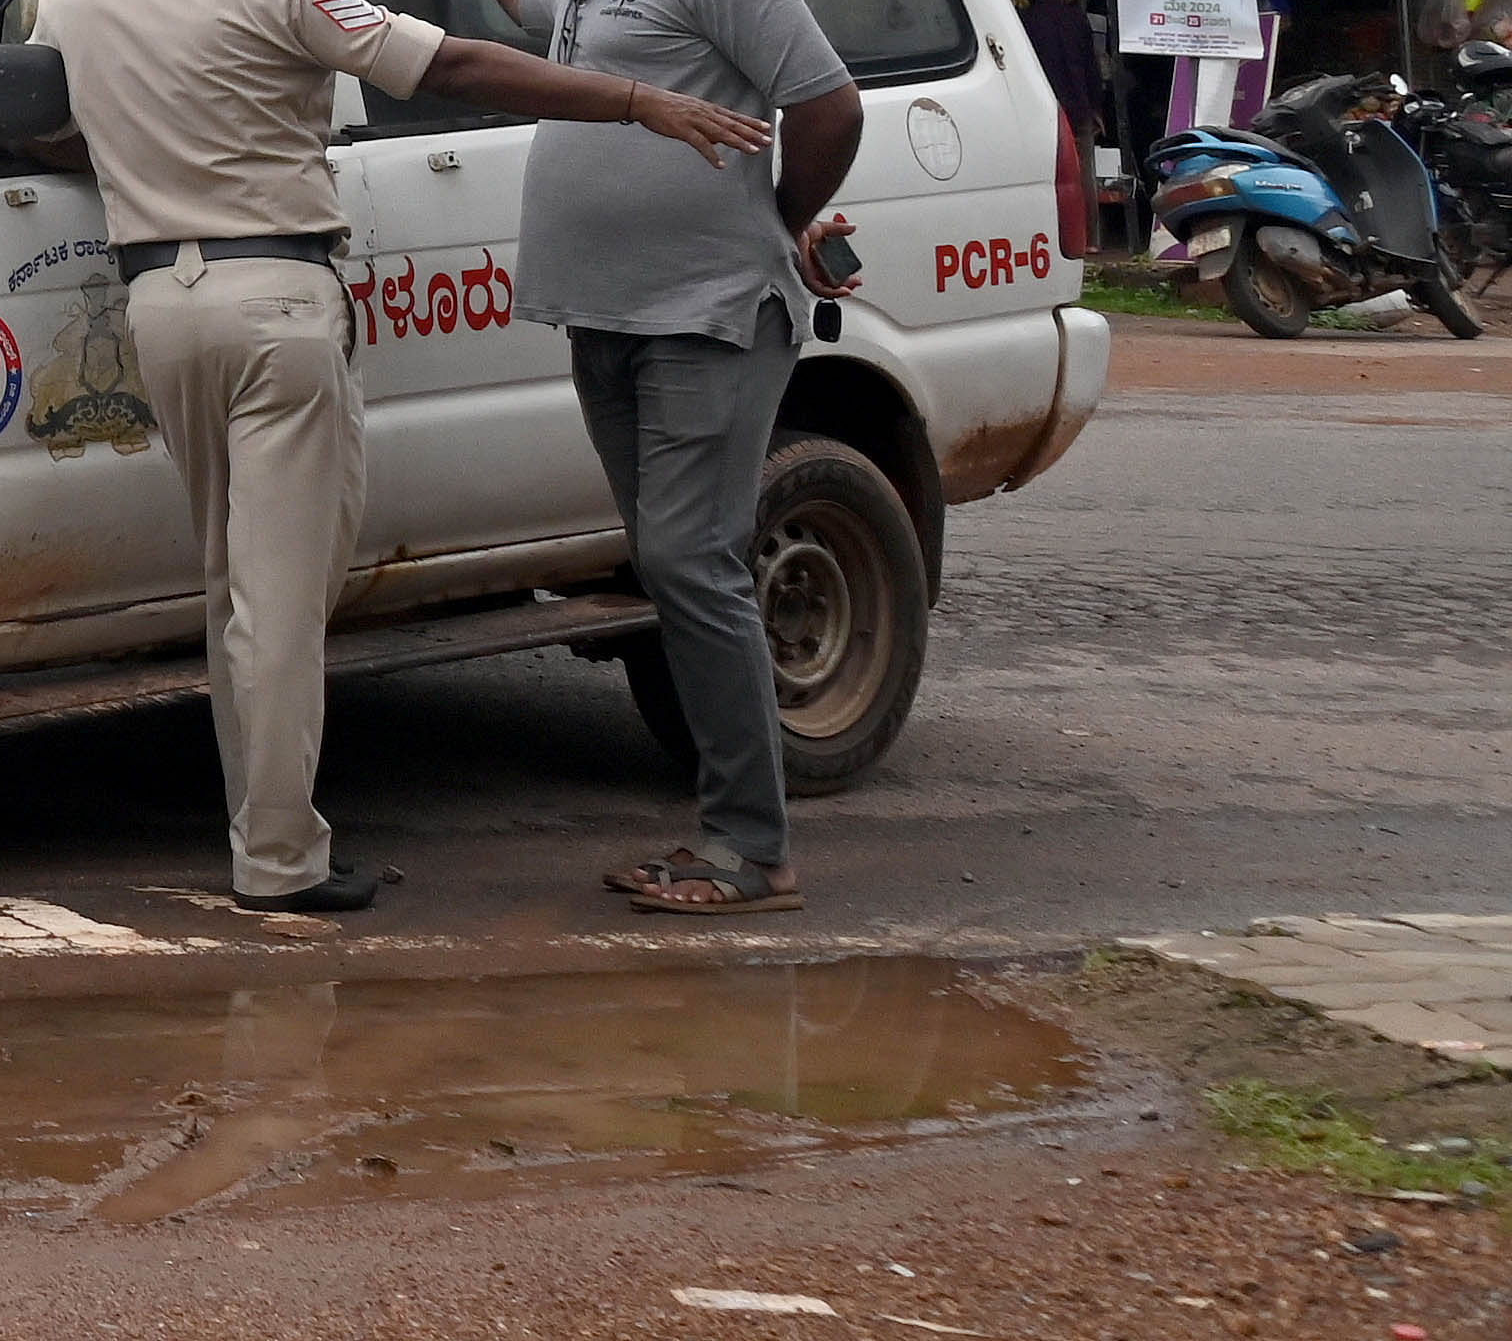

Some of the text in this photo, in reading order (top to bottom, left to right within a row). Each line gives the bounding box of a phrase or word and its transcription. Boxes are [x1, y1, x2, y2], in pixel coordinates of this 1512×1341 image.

[1163, 0, 1222, 14] ಮೇ 2024
[8, 240, 69, 293] ಕರ್ನಾಟಕ
[934, 232, 1050, 293] PCR-6
[349, 247, 513, 346] ಗಳೂರು
